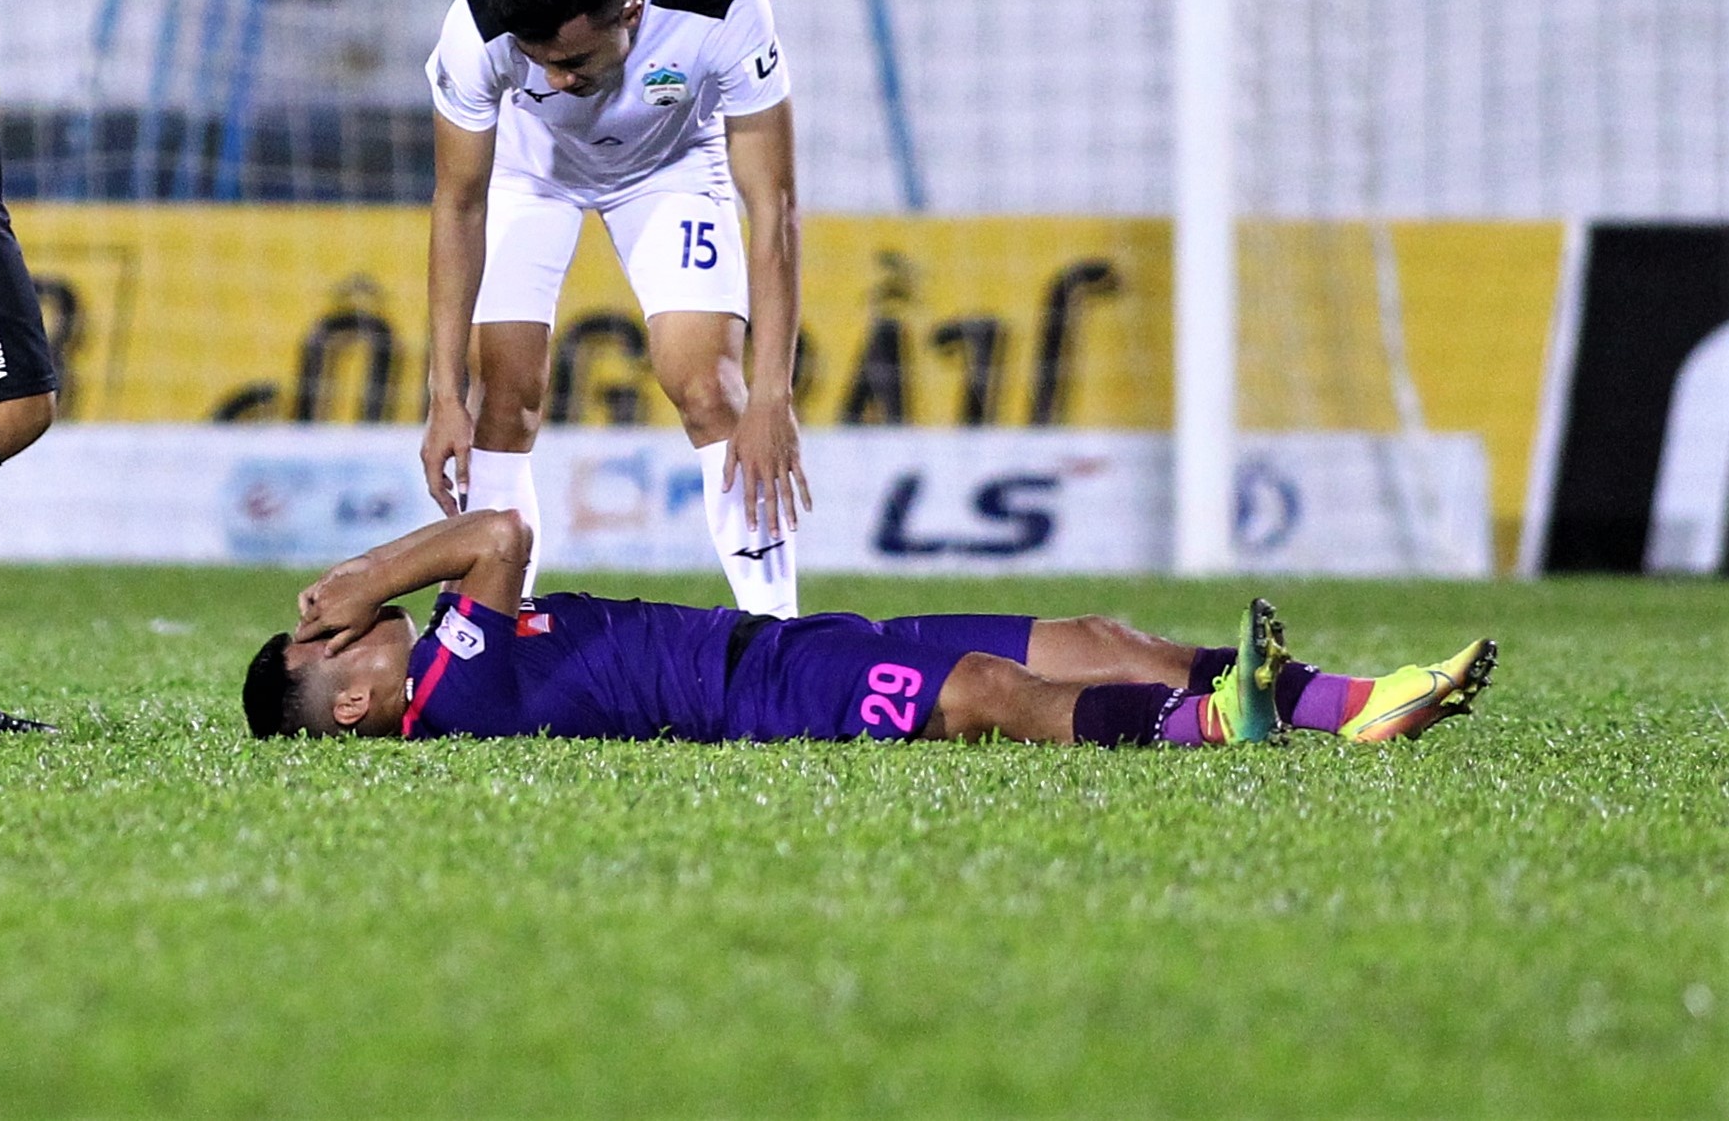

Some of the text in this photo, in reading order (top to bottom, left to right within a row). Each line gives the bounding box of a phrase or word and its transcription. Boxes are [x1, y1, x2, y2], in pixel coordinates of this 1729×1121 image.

[679, 220, 718, 270] 15
[871, 469, 1061, 557] LS
[860, 662, 924, 734] 29
